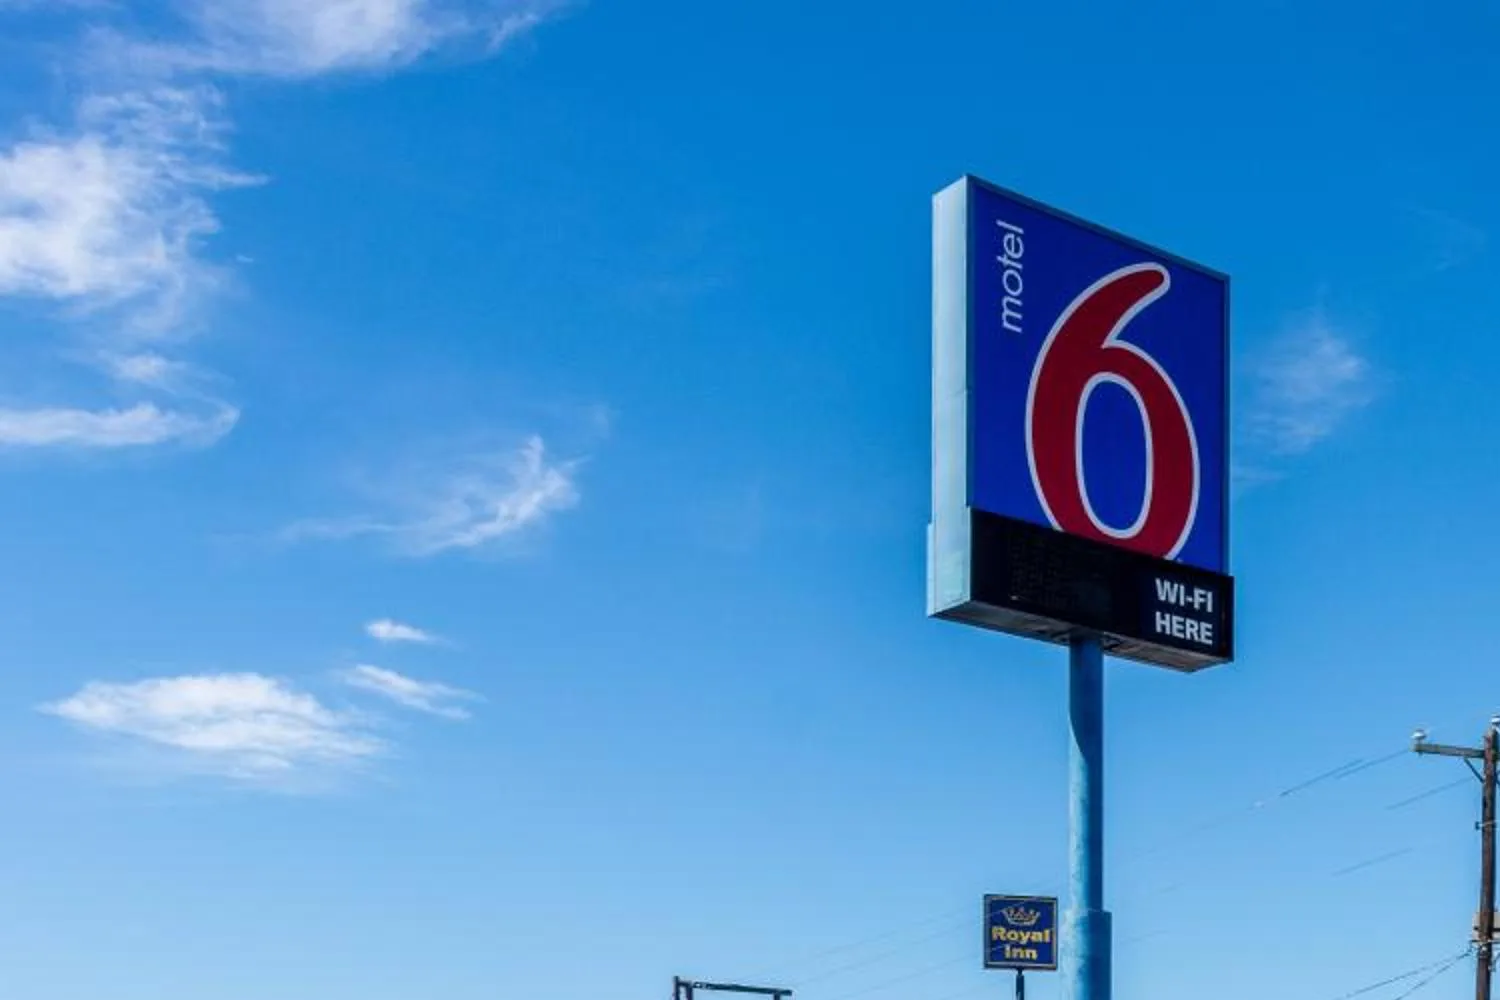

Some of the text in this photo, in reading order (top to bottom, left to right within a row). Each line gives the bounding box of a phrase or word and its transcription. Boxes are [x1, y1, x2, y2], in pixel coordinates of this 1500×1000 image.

[996, 219, 1024, 333] motel
[1025, 262, 1200, 560] 6
[1155, 578, 1213, 613] WI-FI
[1155, 611, 1213, 645] HERE
[991, 926, 1050, 945] Royal
